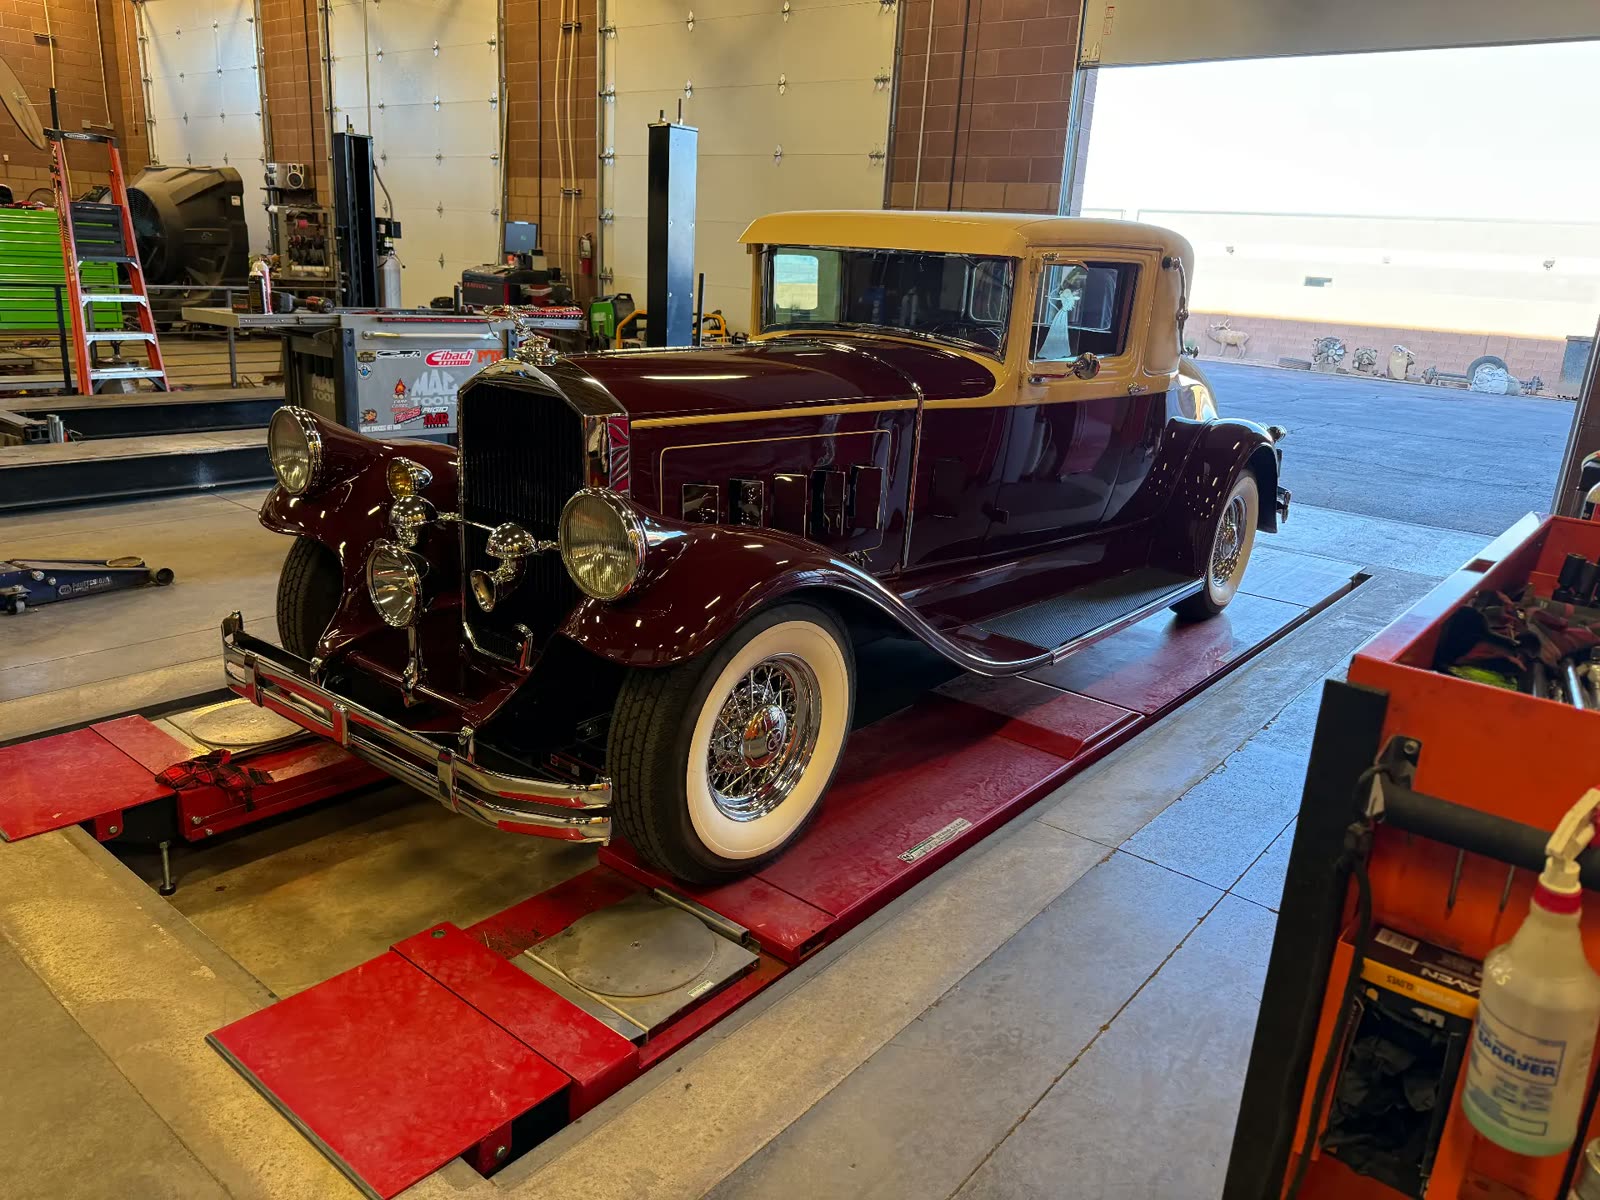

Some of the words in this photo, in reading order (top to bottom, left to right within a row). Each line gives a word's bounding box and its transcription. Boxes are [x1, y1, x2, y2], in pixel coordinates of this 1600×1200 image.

[426, 350, 473, 365] Eibach
[411, 369, 459, 396] MAC
[1421, 967, 1480, 993] AVEN
[1478, 1029, 1556, 1078] SPRAYER
